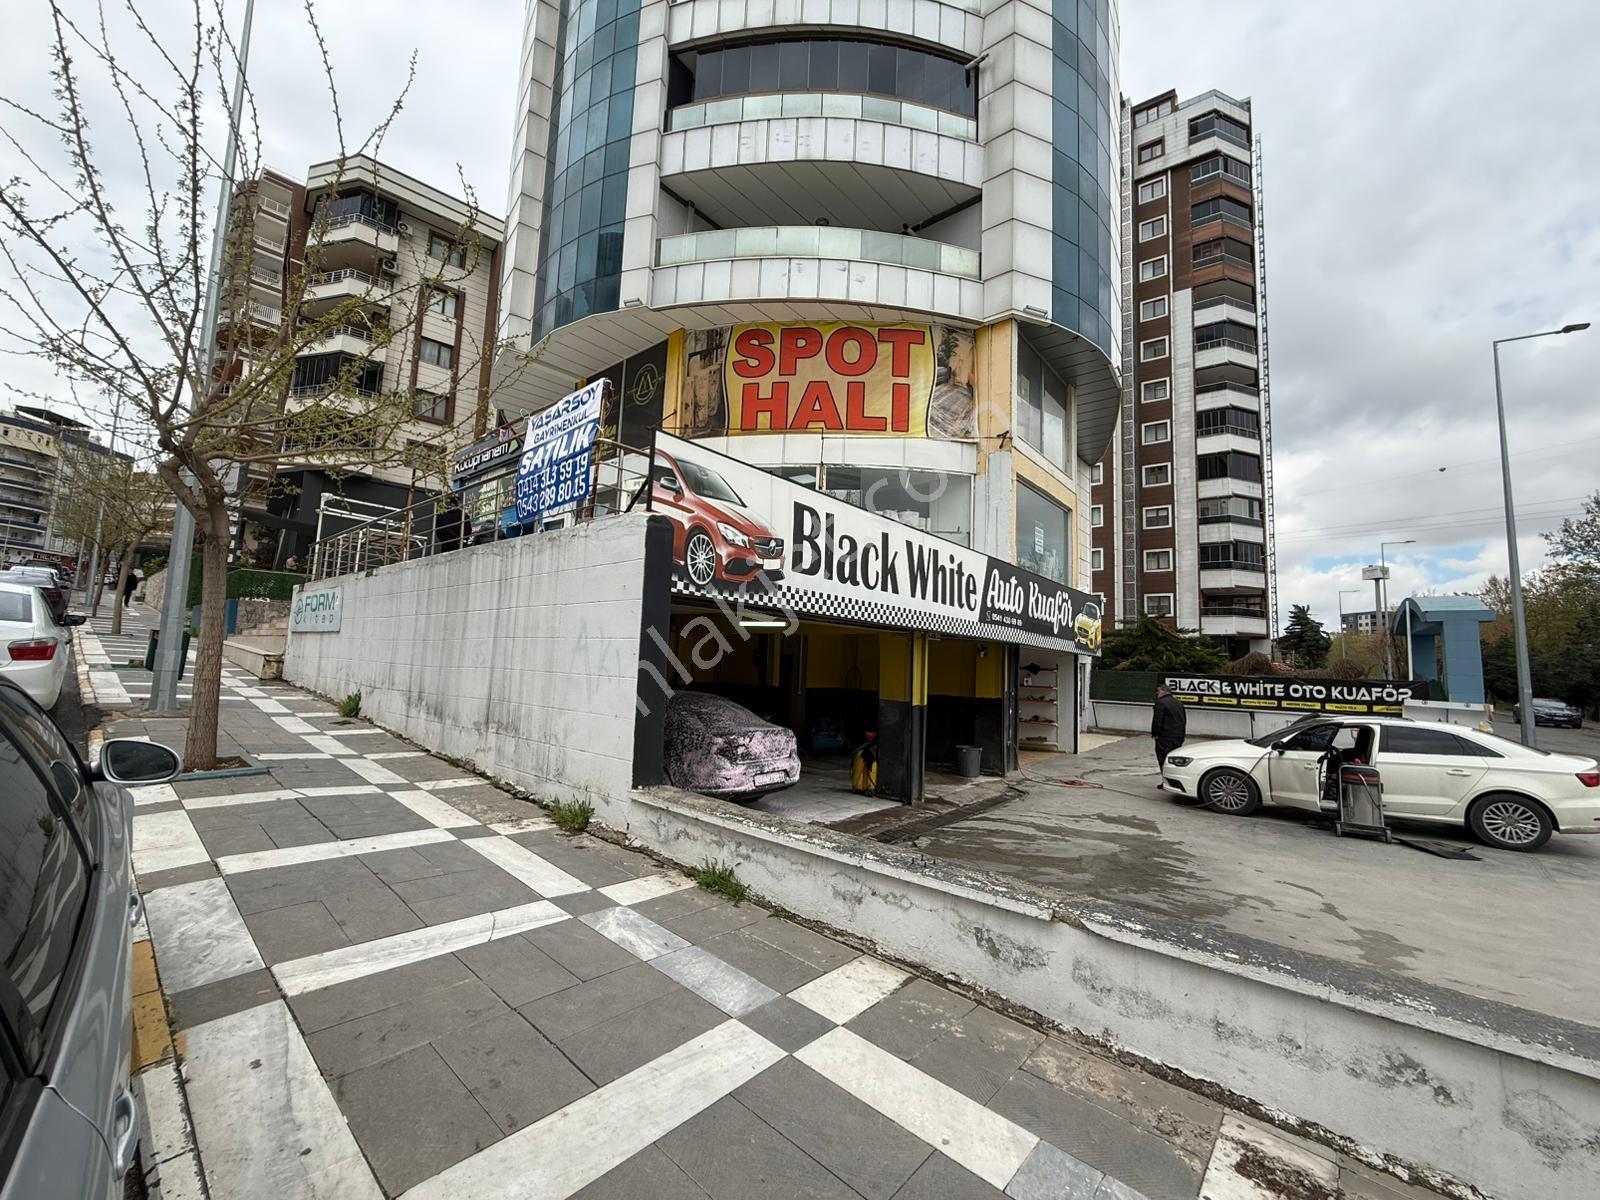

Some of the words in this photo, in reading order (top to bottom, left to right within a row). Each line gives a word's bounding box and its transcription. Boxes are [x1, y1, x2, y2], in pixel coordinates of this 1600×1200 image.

[732, 326, 926, 379] SPOT
[531, 382, 600, 432] YAŞARSOY
[533, 408, 588, 444] GAYRİMENKUL
[740, 380, 911, 433] HALI
[519, 422, 597, 476] SATILIK
[516, 493, 539, 518] 0543
[539, 485, 556, 510] 289
[557, 480, 571, 502] 80
[573, 474, 586, 497] 15
[517, 473, 539, 498] 0414
[540, 465, 557, 489] 313
[559, 459, 572, 481] 59
[574, 452, 588, 475] 19
[791, 500, 900, 596] Black
[905, 539, 978, 612] White
[986, 568, 1025, 615] Auto
[1028, 581, 1075, 635] Kuaför
[304, 591, 336, 612] FORM
[1168, 680, 1217, 694] BLACK
[1221, 682, 1232, 694] &
[1289, 684, 1326, 699] OTO
[1331, 684, 1412, 702] KUAFÖR
